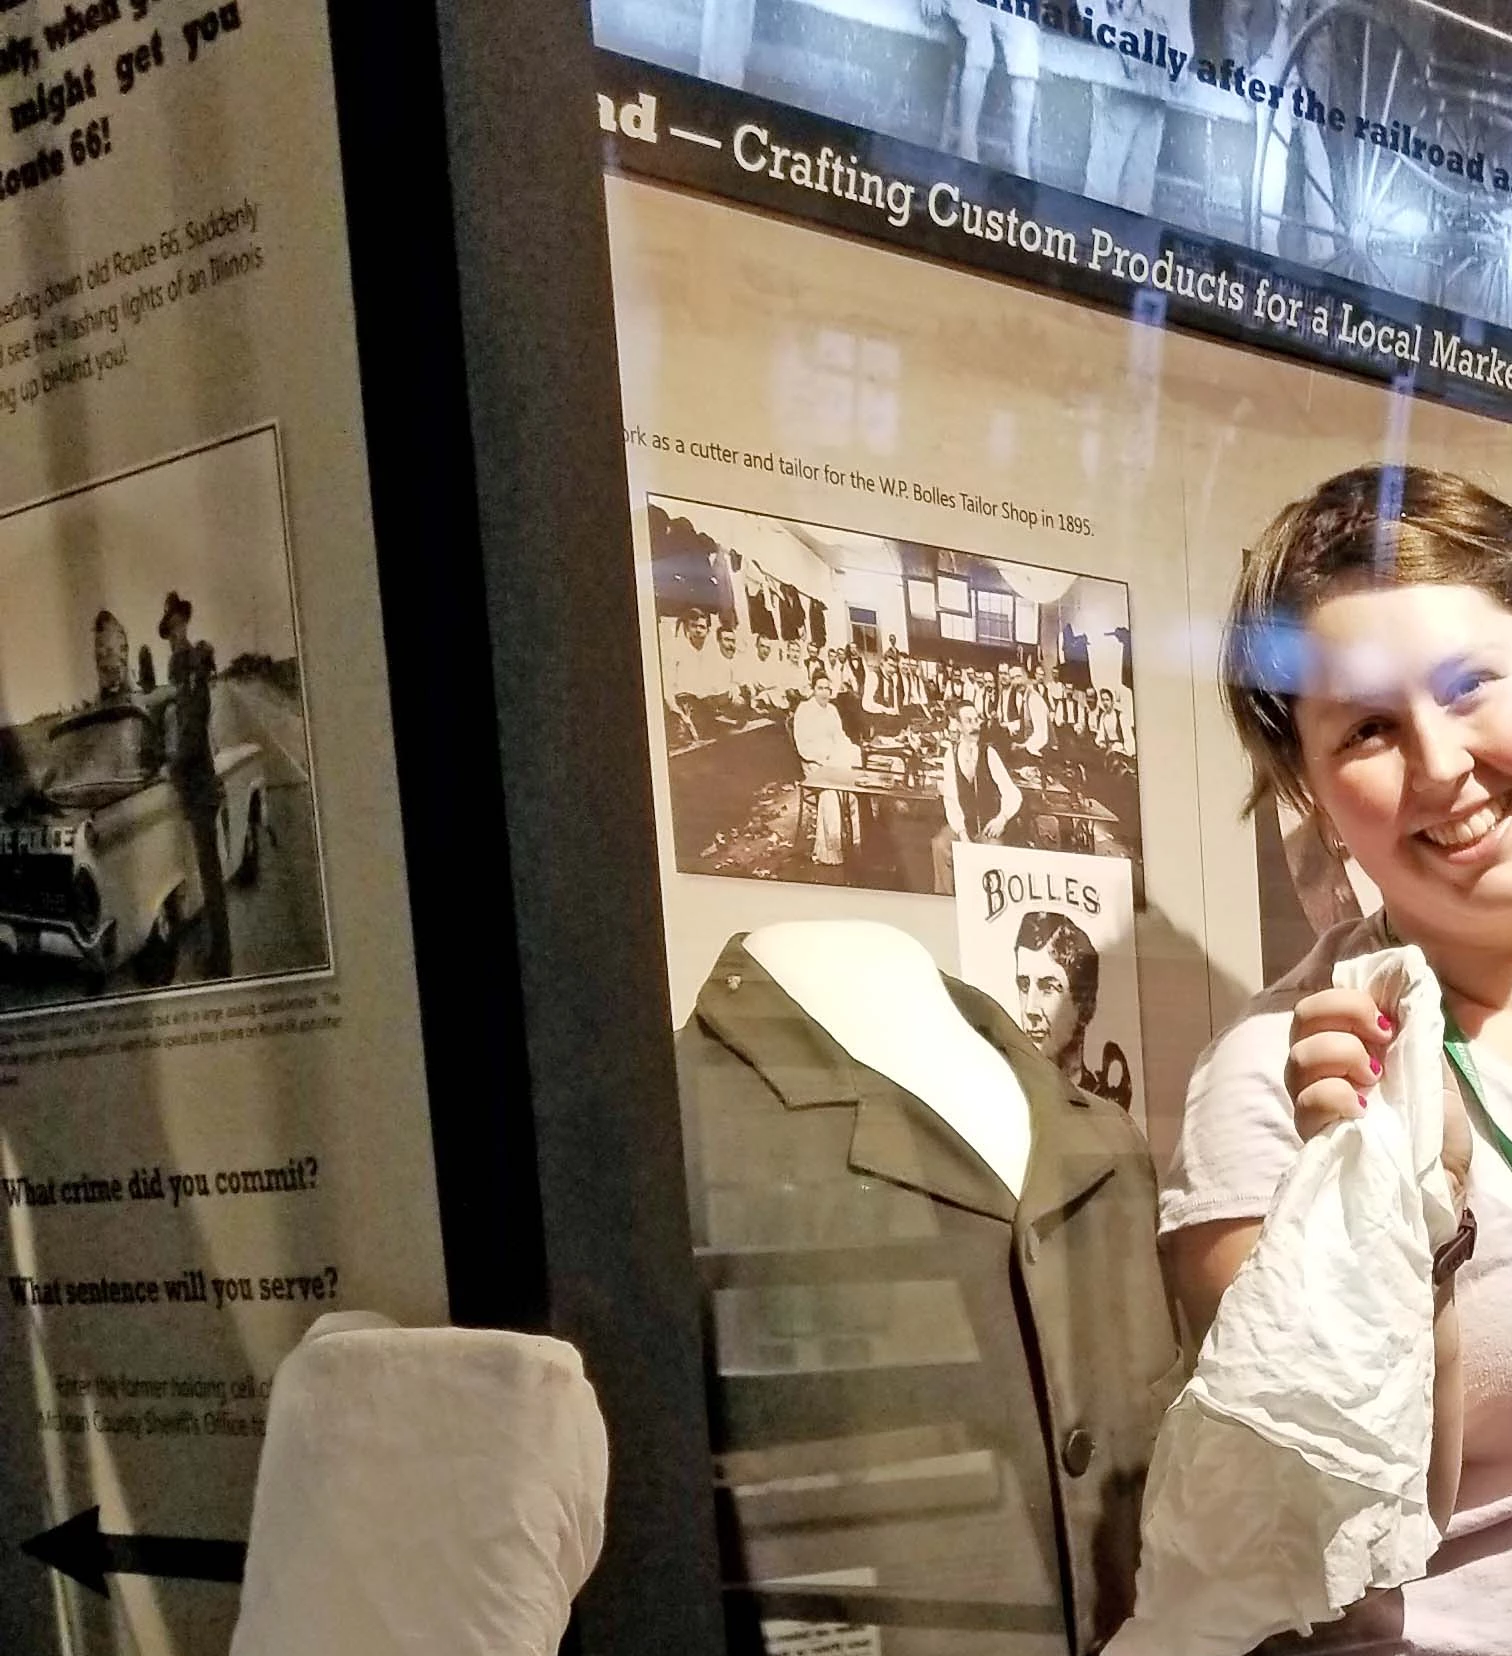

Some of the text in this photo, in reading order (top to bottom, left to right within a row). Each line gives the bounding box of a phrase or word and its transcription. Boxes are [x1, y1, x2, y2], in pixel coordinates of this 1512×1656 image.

[10, 64, 96, 133] might
[116, 28, 164, 94] get
[182, 1, 242, 63] you
[0, 117, 112, 200] oute 66!
[1198, 56, 1283, 109] after
[1292, 87, 1346, 132] the
[1354, 115, 1485, 182] railroad
[113, 243, 157, 278] Route
[185, 198, 258, 250] Suddenly
[733, 123, 916, 228] Crafting
[927, 182, 1079, 265] Custom
[1089, 227, 1246, 311] Products
[1254, 278, 1305, 329] for
[1312, 309, 1330, 337] a
[1341, 302, 1422, 365] Local
[120, 284, 164, 324] lights
[168, 268, 182, 302] of
[188, 269, 207, 296] an
[652, 435, 671, 452] as
[675, 439, 686, 455] a
[690, 440, 739, 465] cutter
[743, 448, 774, 472] and
[778, 455, 820, 482] tailor
[824, 463, 847, 486] for
[849, 469, 876, 493] the
[879, 476, 910, 501] W.P.
[913, 484, 956, 510] Bolles
[959, 492, 999, 518] Tailor
[1001, 501, 1039, 529] Shop
[1041, 509, 1055, 530] in
[1058, 513, 1095, 538] 1895.
[982, 869, 1101, 923] BOLLES
[1, 1156, 318, 1208] What crime did you commit?
[8, 1267, 338, 1309] What sentence will you serve?
